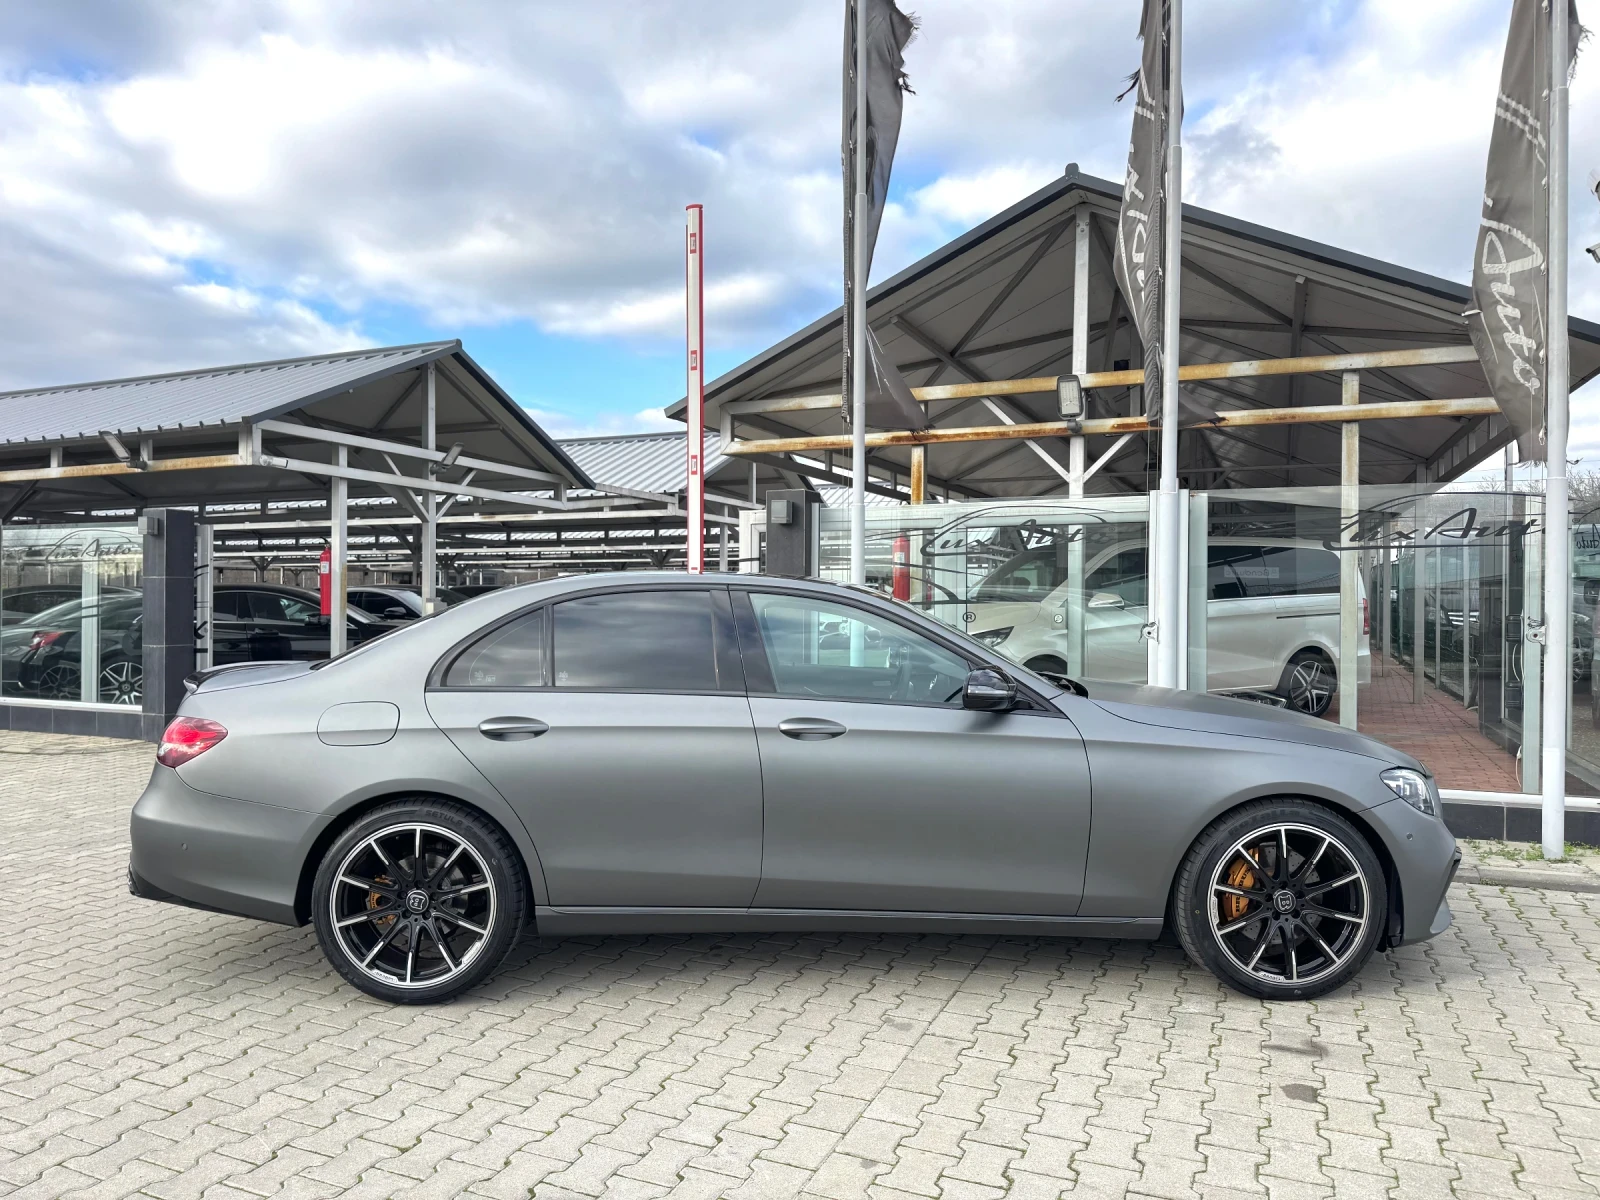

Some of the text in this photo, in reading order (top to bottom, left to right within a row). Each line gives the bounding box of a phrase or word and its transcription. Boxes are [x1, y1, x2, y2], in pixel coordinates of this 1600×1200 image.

[1481, 216, 1544, 395] Auto
[920, 517, 1109, 556] Lux Auto
[1424, 507, 1545, 540] Aut
[80, 538, 132, 558] Auto
